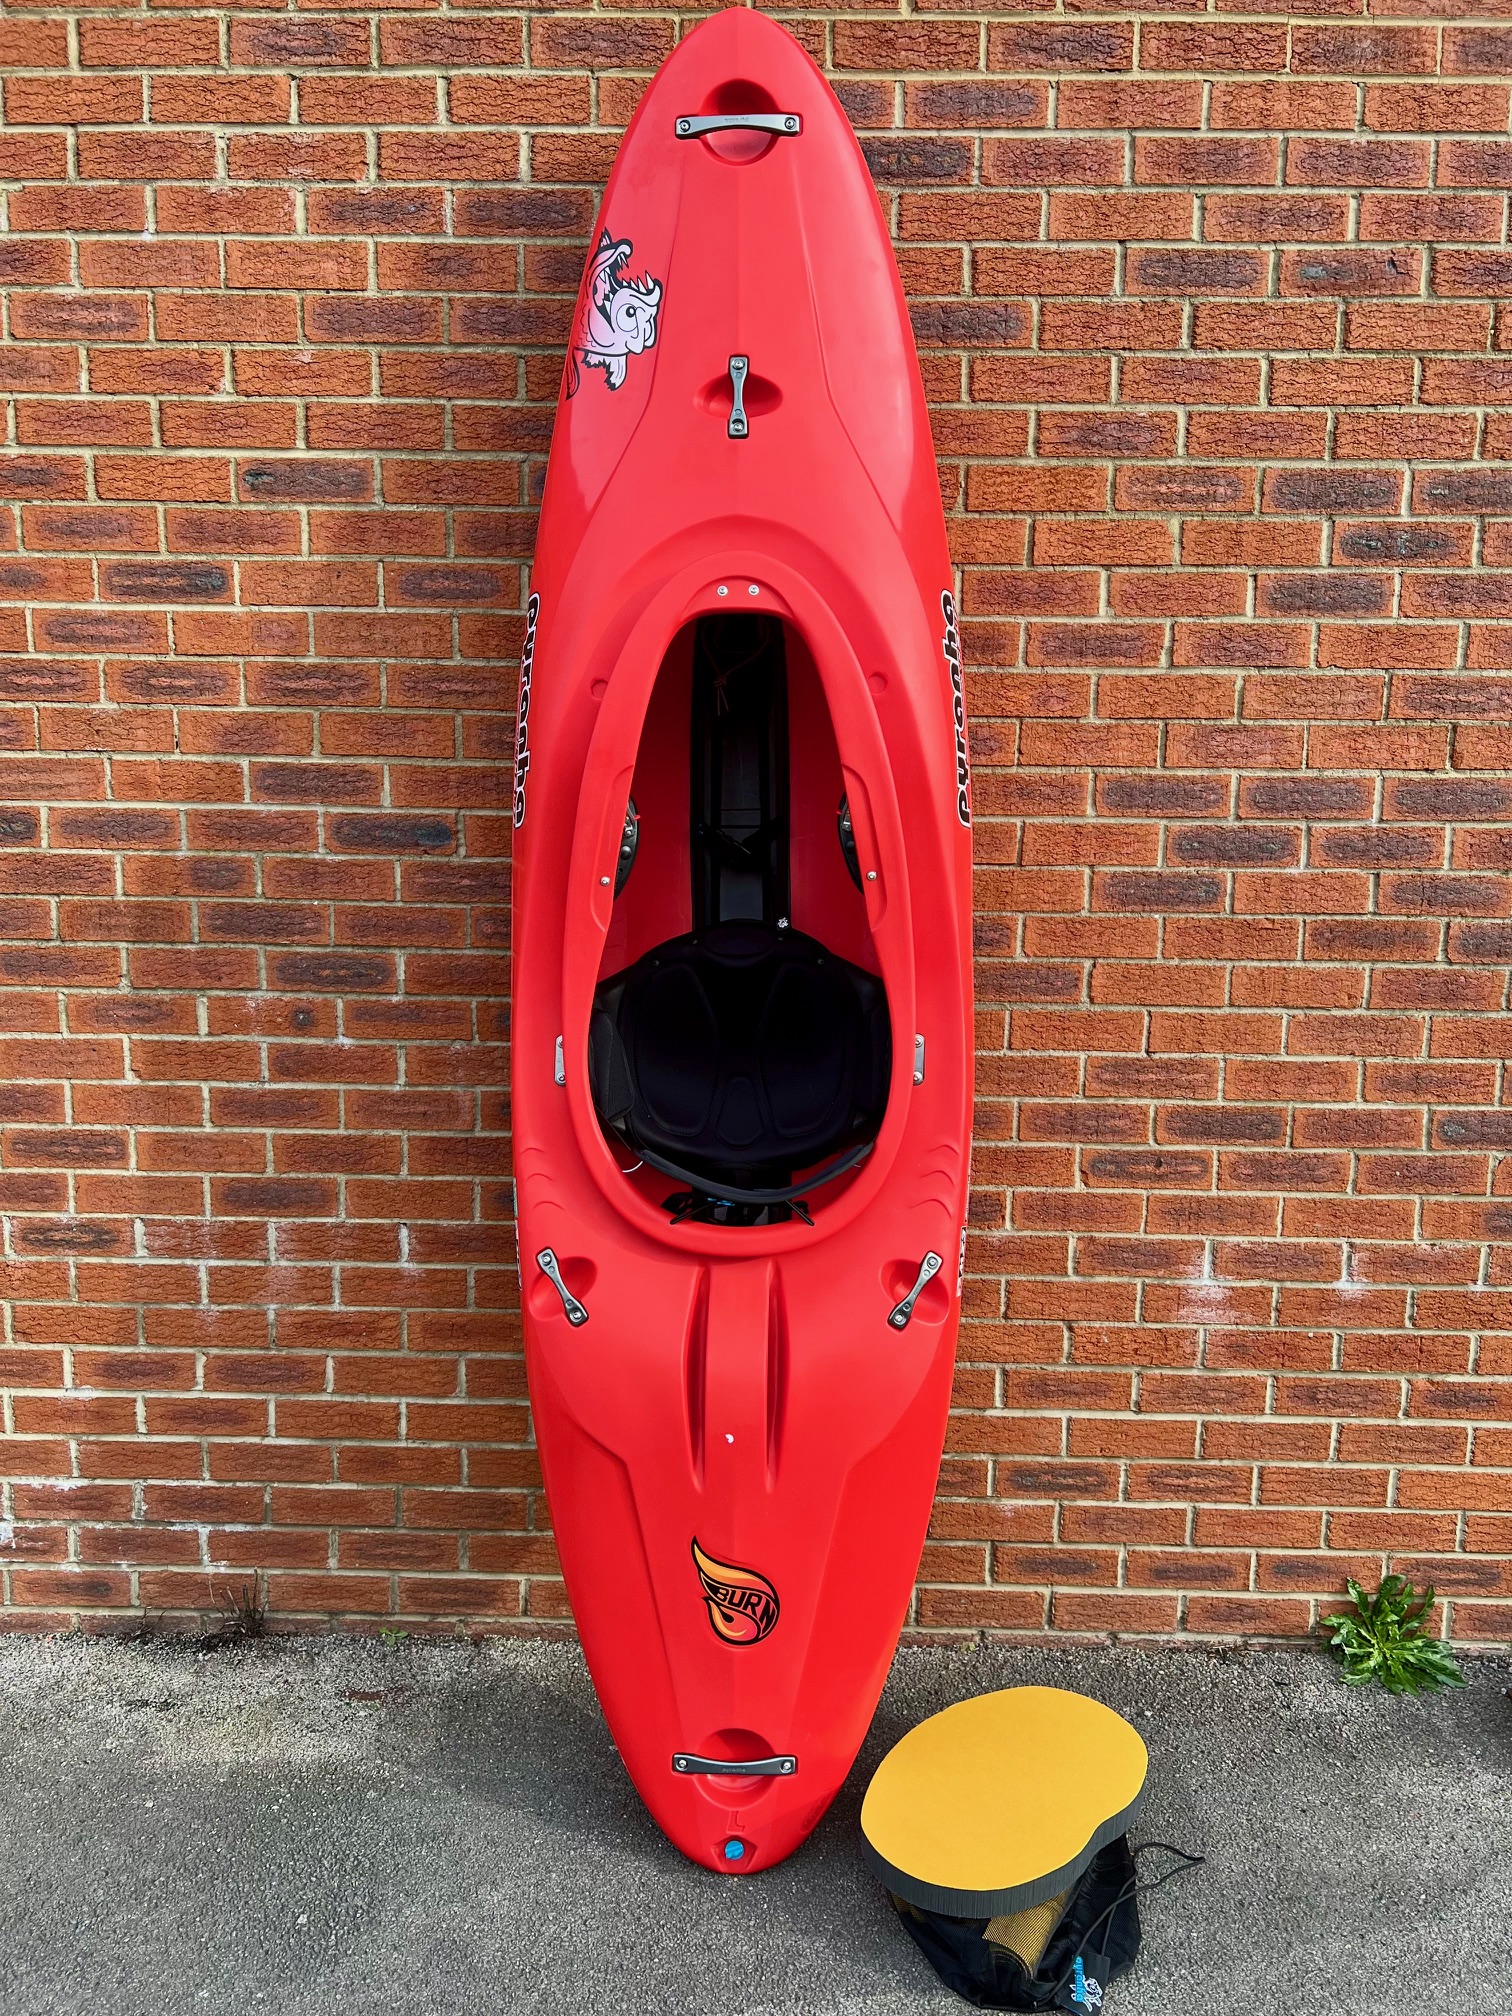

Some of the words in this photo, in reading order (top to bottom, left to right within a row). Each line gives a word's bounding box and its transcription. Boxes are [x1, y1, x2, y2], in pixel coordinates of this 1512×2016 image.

[513, 592, 540, 829] pyranha
[940, 589, 971, 829] pyranha
[714, 1588, 776, 1635] BURN
